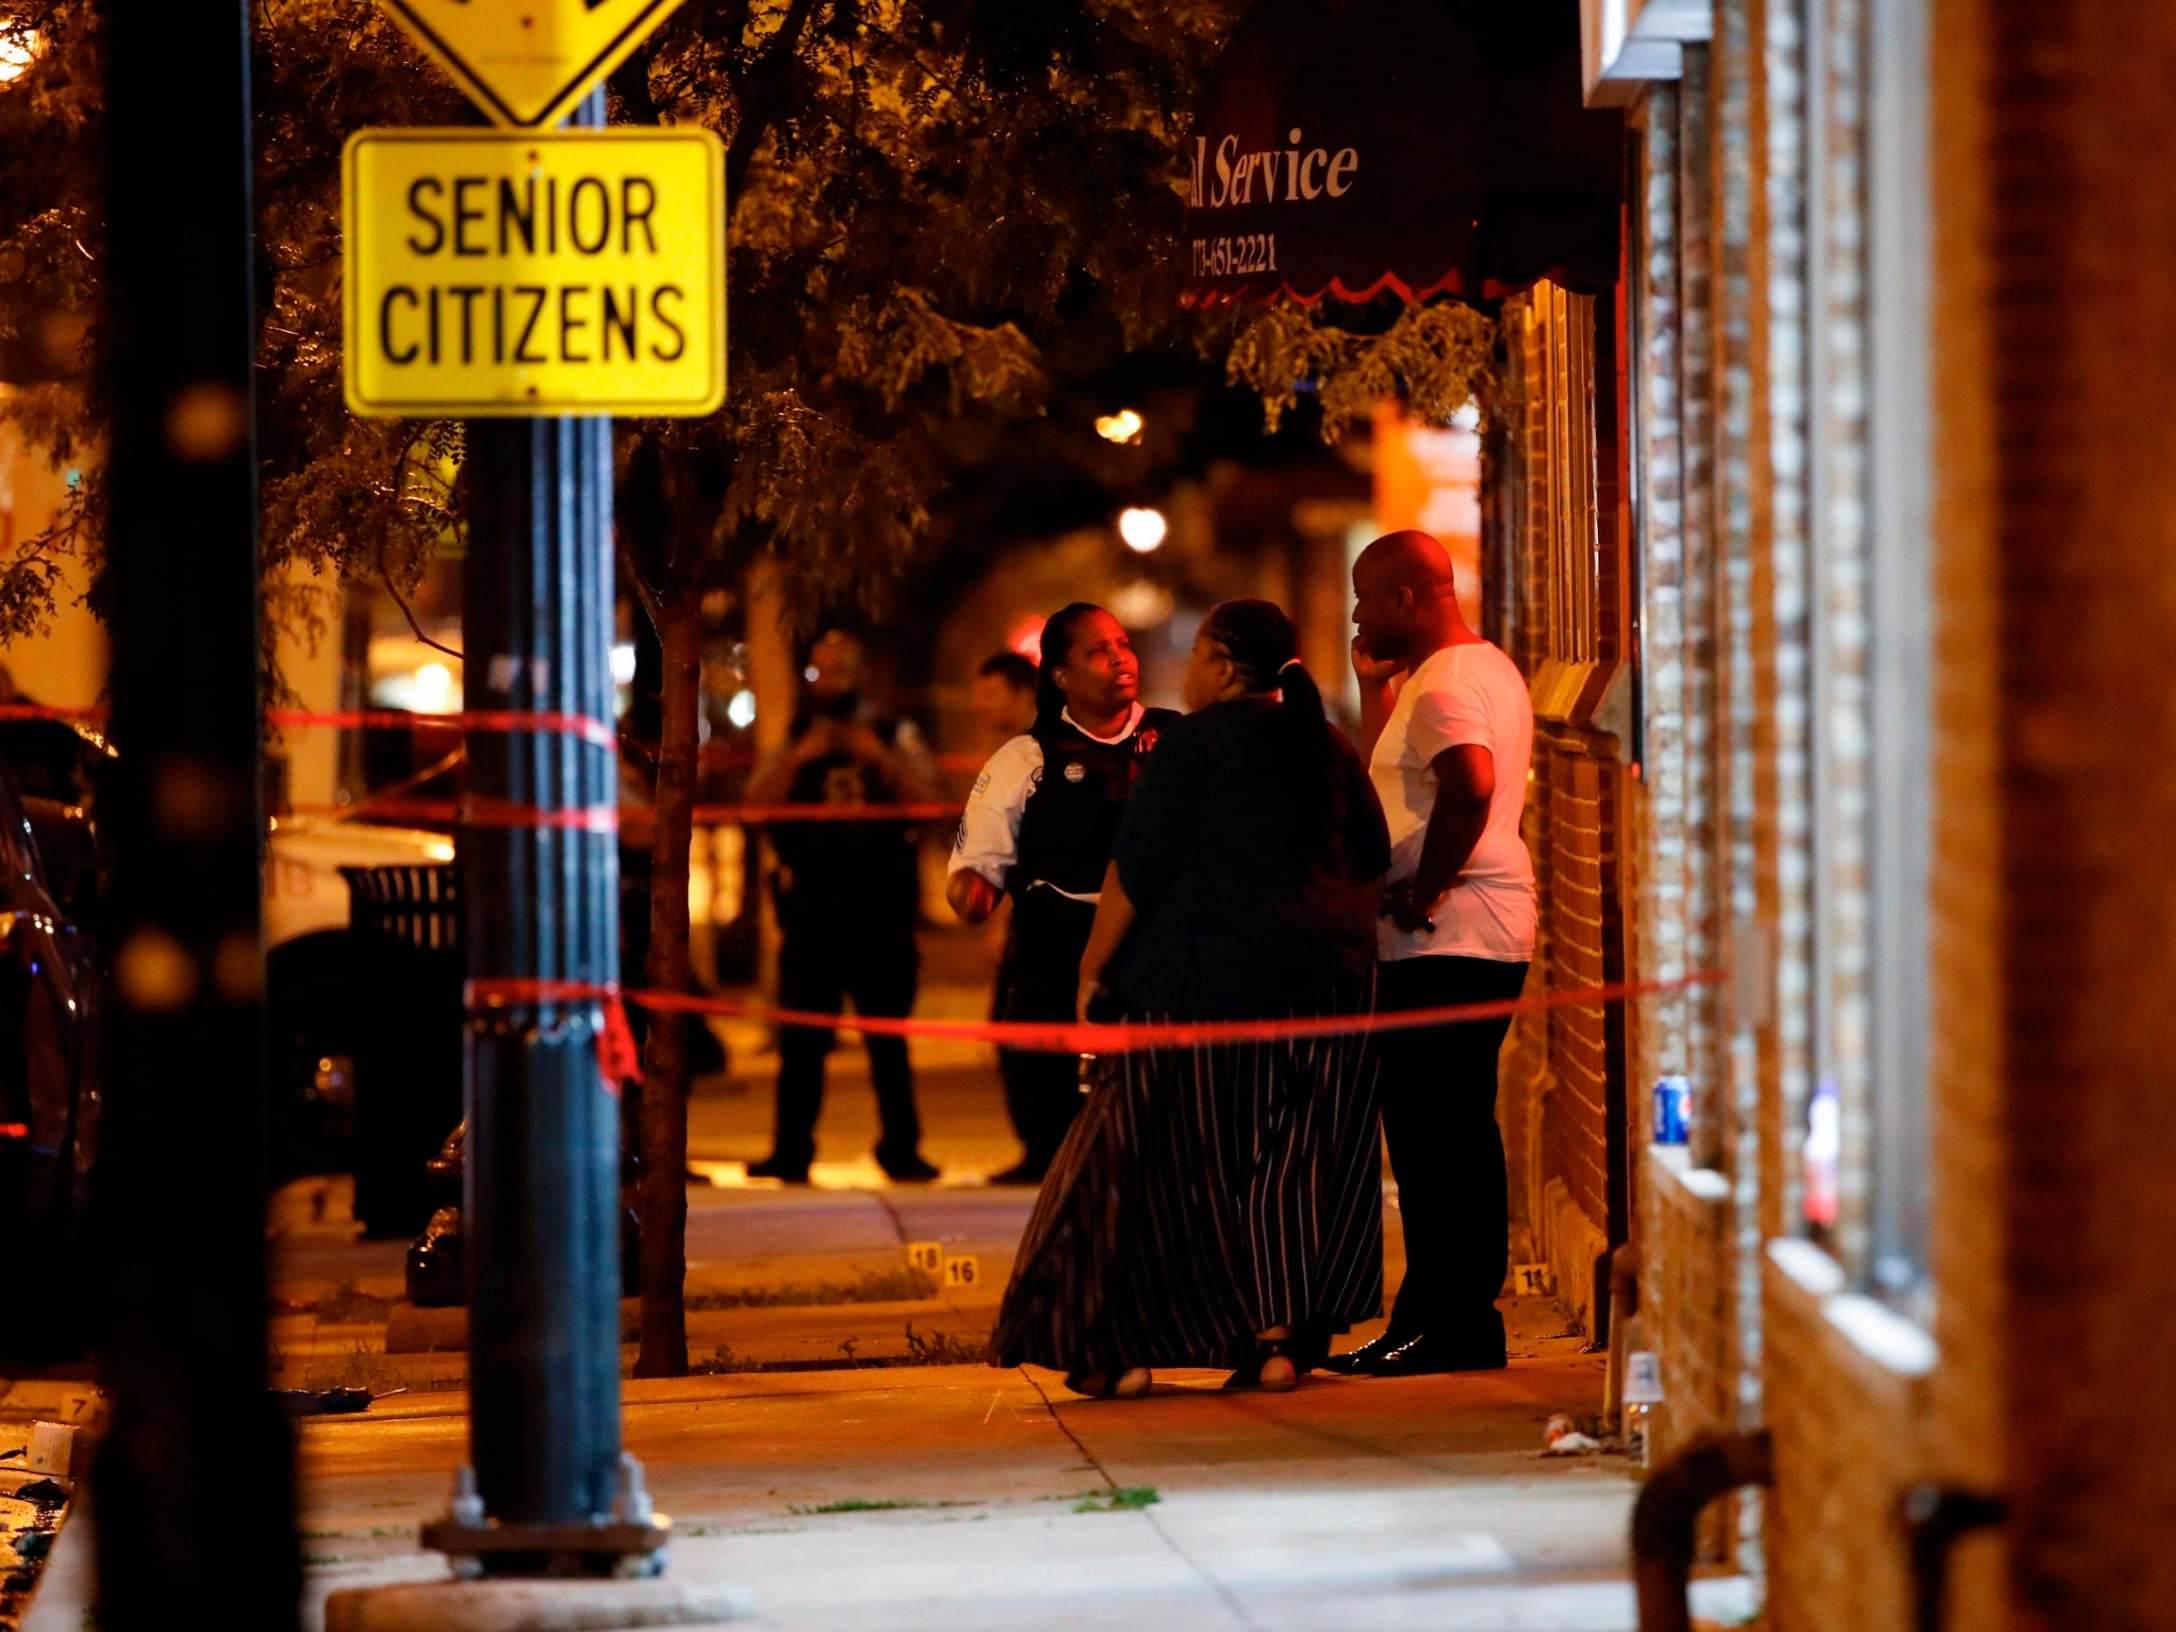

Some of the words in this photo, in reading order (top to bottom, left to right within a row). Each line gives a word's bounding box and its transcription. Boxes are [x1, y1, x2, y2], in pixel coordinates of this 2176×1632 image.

[1211, 127, 1358, 208] Service
[406, 175, 657, 256] SENIOR
[379, 285, 686, 365] CITIZENS
[951, 1261, 974, 1283] 16
[72, 1399, 87, 1416] 7
